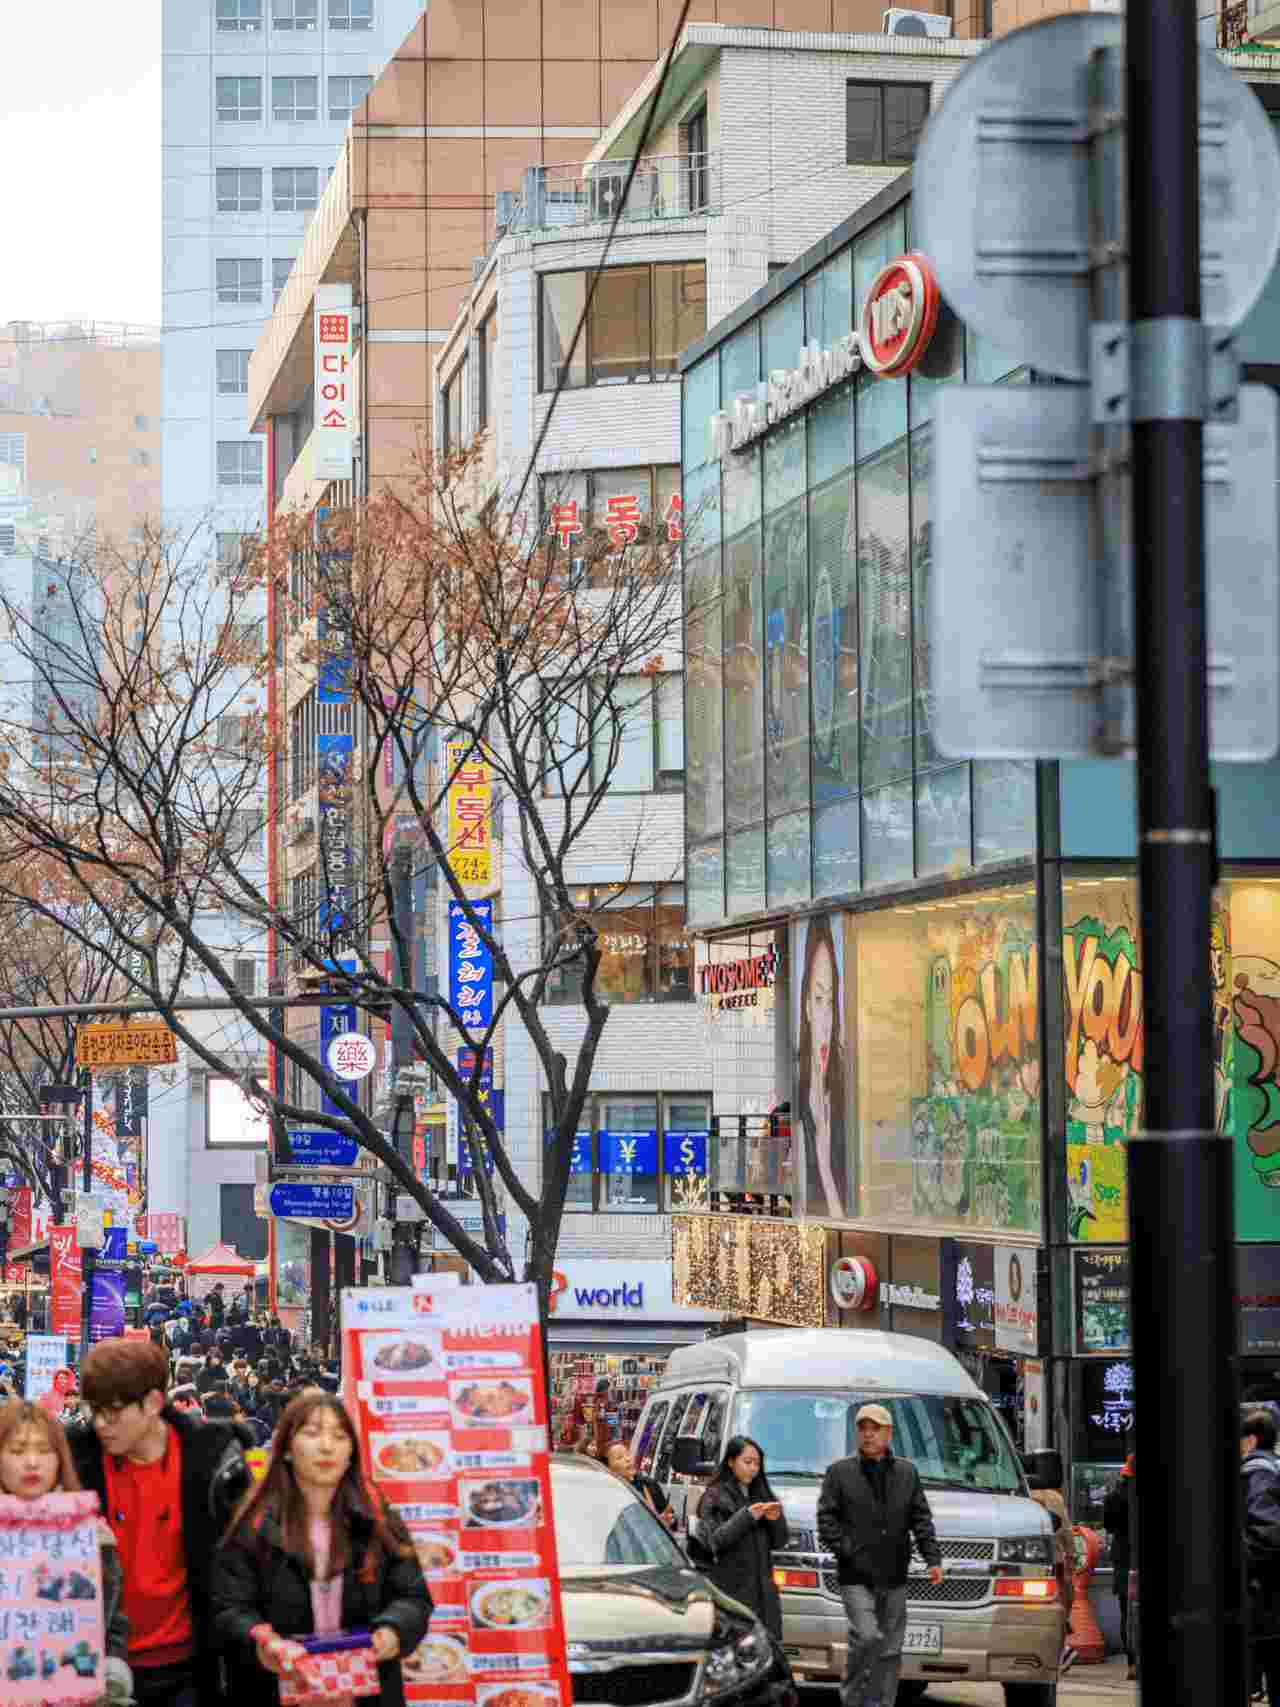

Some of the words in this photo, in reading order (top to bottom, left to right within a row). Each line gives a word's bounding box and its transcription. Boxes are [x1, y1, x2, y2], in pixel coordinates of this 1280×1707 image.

[321, 355, 348, 427] 다이소
[456, 769, 488, 851] 부동산
[574, 1281, 644, 1309] world
